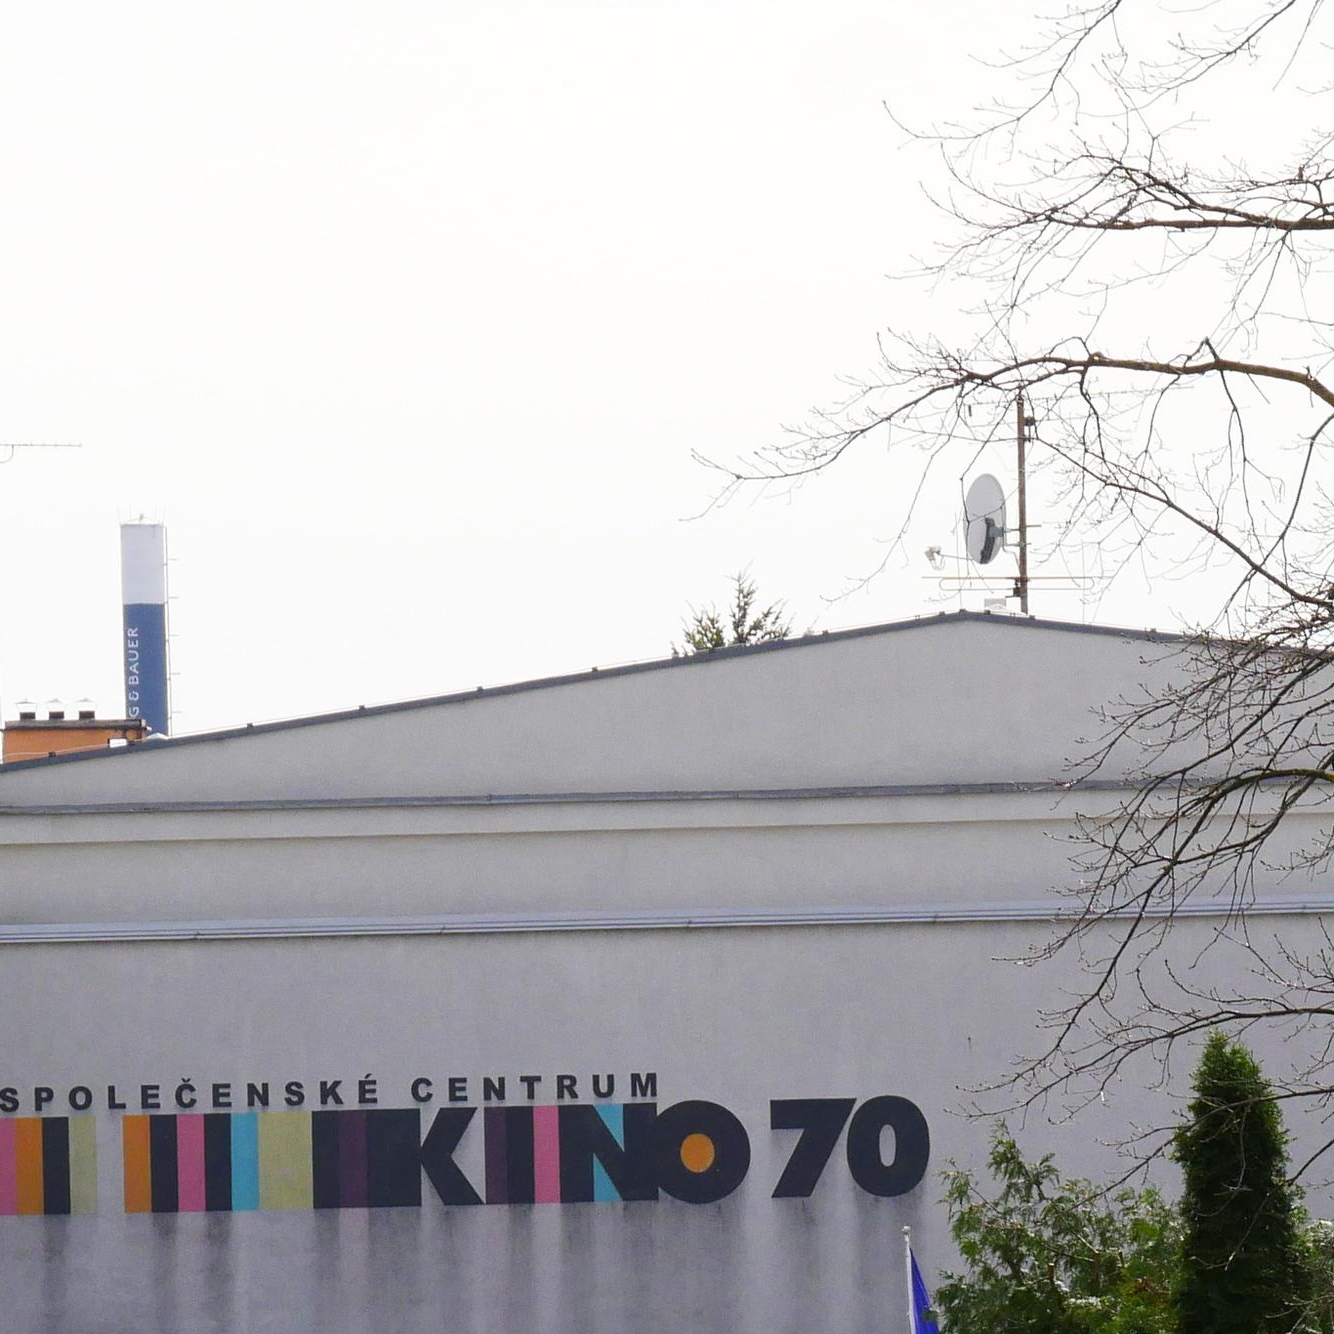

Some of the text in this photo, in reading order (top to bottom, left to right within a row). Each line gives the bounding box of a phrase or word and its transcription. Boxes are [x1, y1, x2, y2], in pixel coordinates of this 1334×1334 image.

[128, 627, 140, 685] BAUER
[410, 1073, 658, 1104] CENTRUM
[367, 1095, 931, 1208] KINO 70
